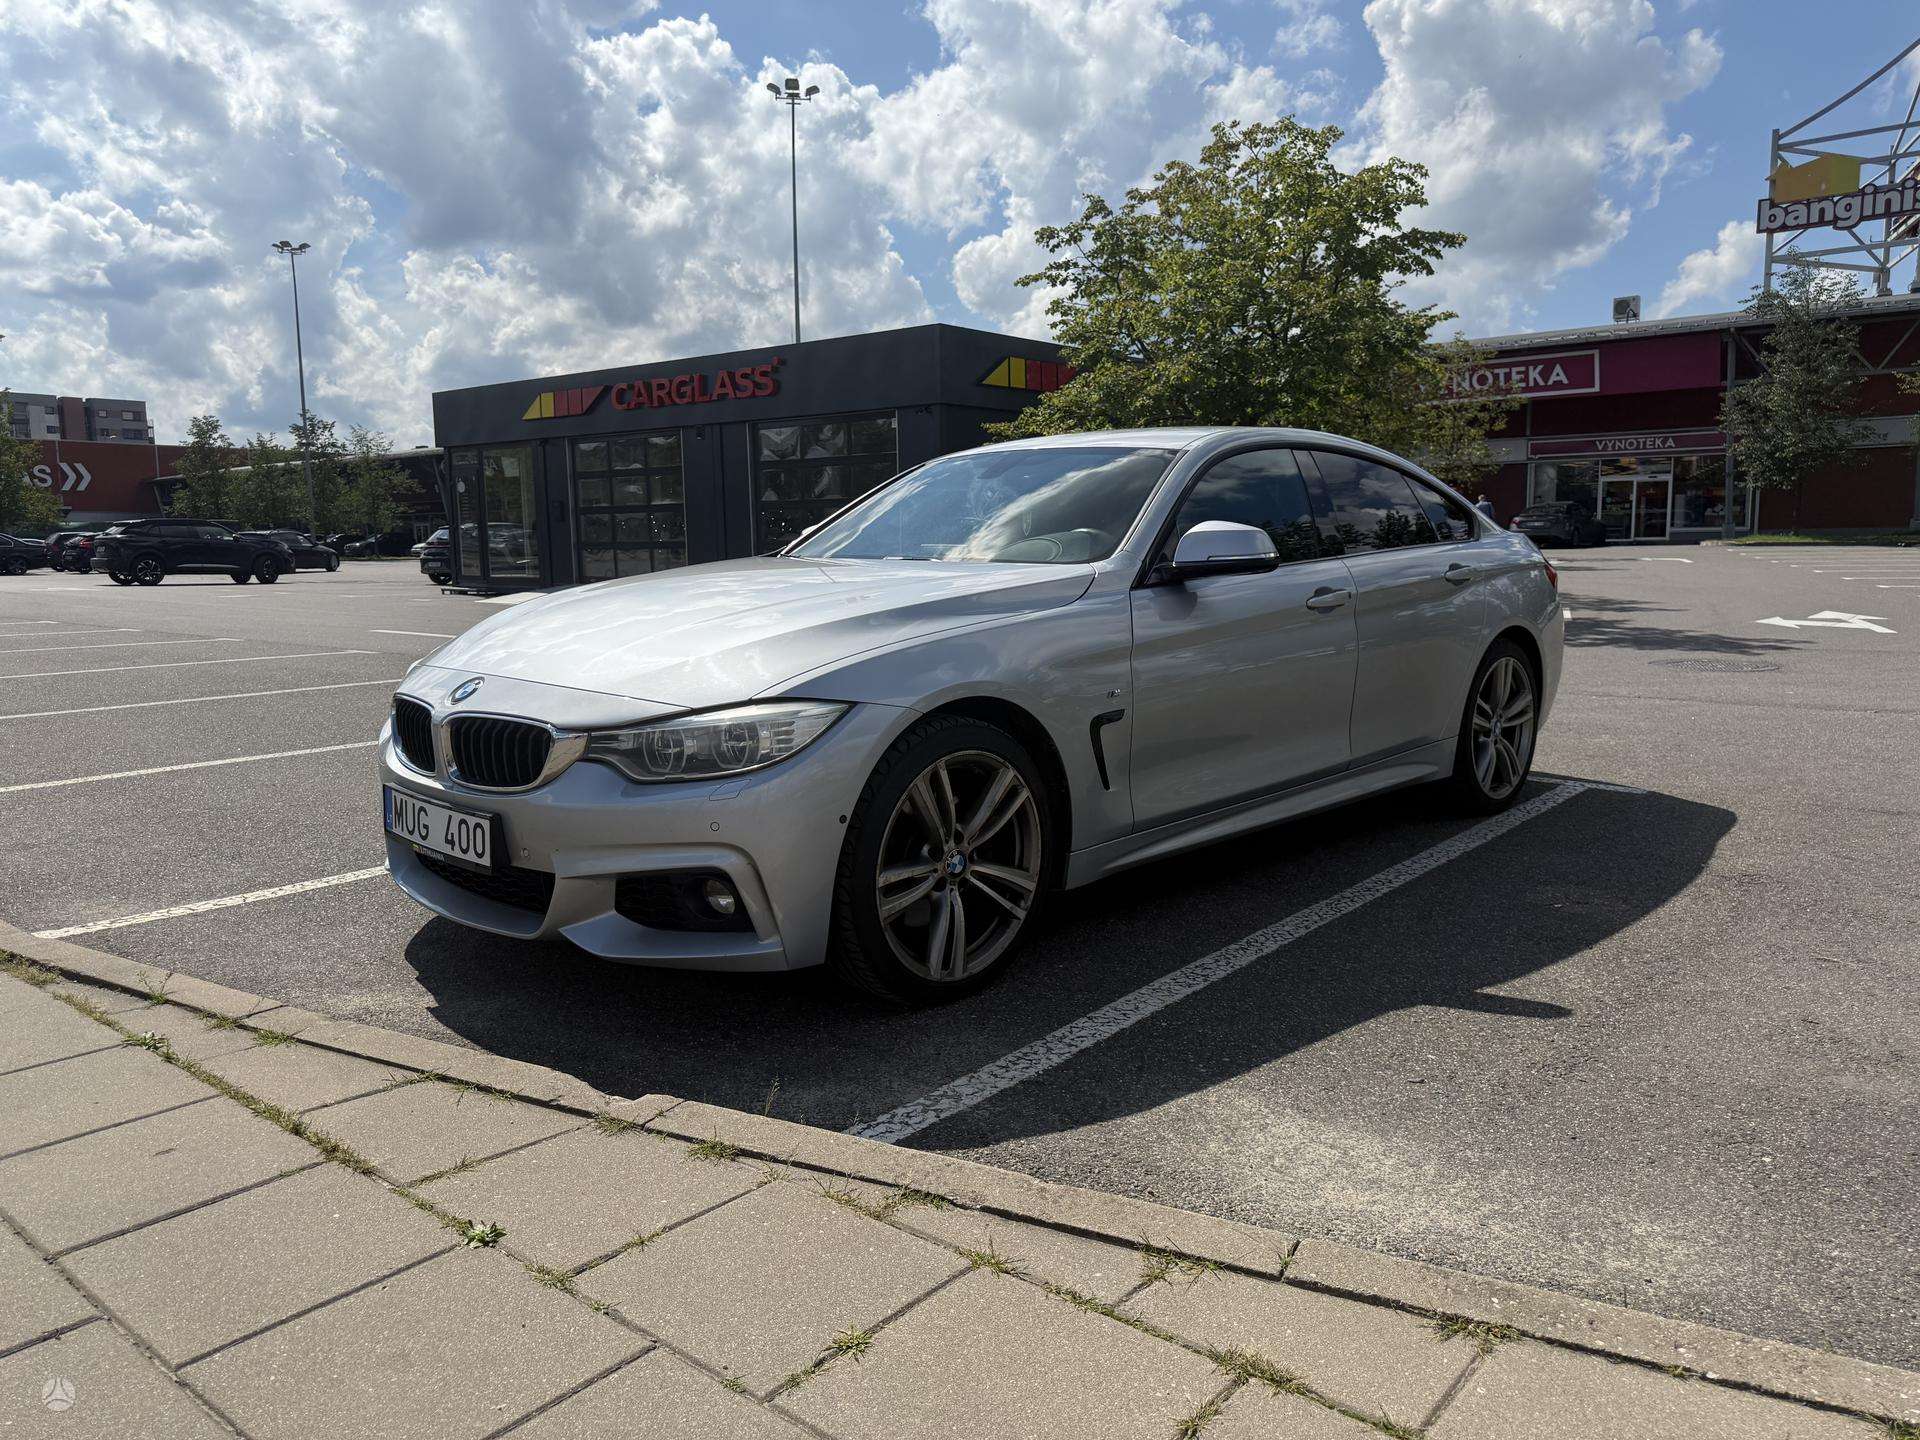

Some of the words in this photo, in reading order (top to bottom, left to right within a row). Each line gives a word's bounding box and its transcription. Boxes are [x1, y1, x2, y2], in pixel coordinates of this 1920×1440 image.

[1758, 178, 1920, 230] bangini
[612, 365, 778, 410] CARGLASS
[1424, 362, 1570, 396] NOTEKA
[1595, 436, 1676, 451] VYNOTEKA
[393, 794, 430, 841] MUG
[444, 814, 486, 859] 400
